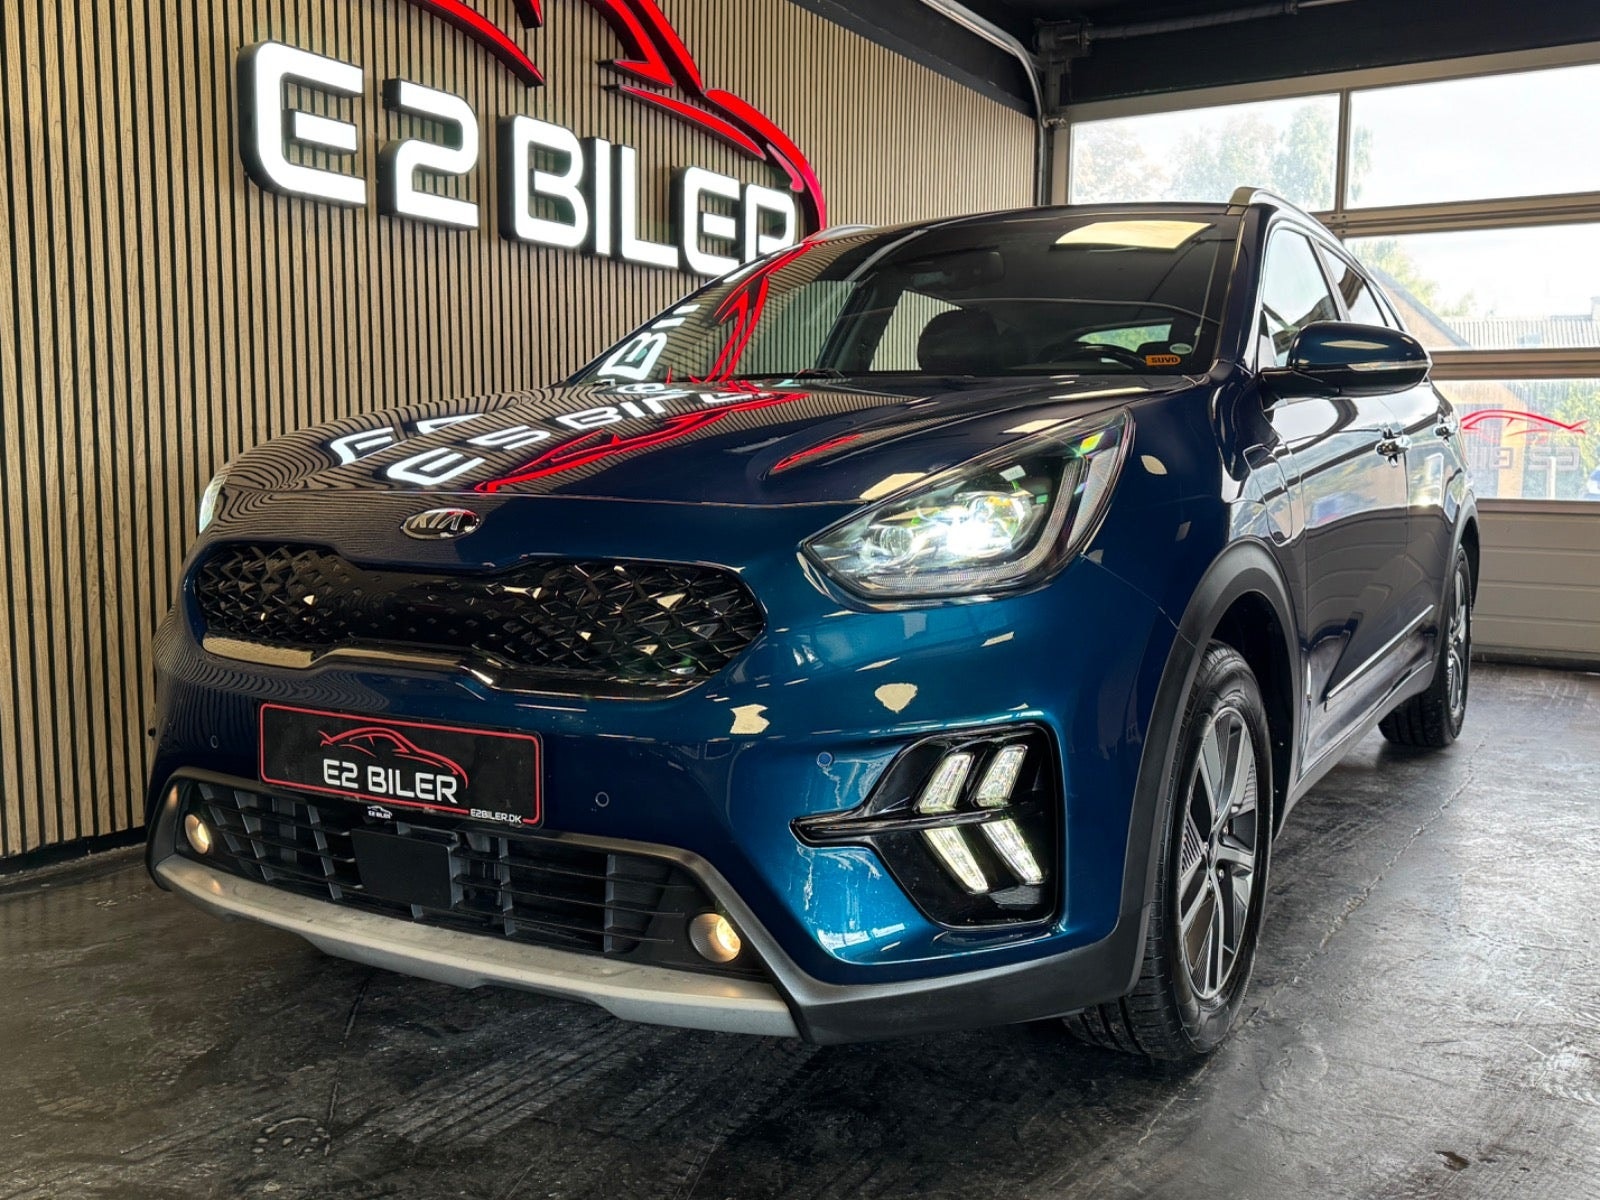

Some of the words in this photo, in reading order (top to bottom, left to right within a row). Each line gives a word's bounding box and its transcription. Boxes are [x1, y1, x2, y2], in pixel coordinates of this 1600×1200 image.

[238, 40, 479, 231] E2
[410, 511, 464, 531] KIA
[323, 758, 359, 789] E2
[367, 765, 457, 803] BILER
[470, 808, 522, 824] E2BILER.DK
